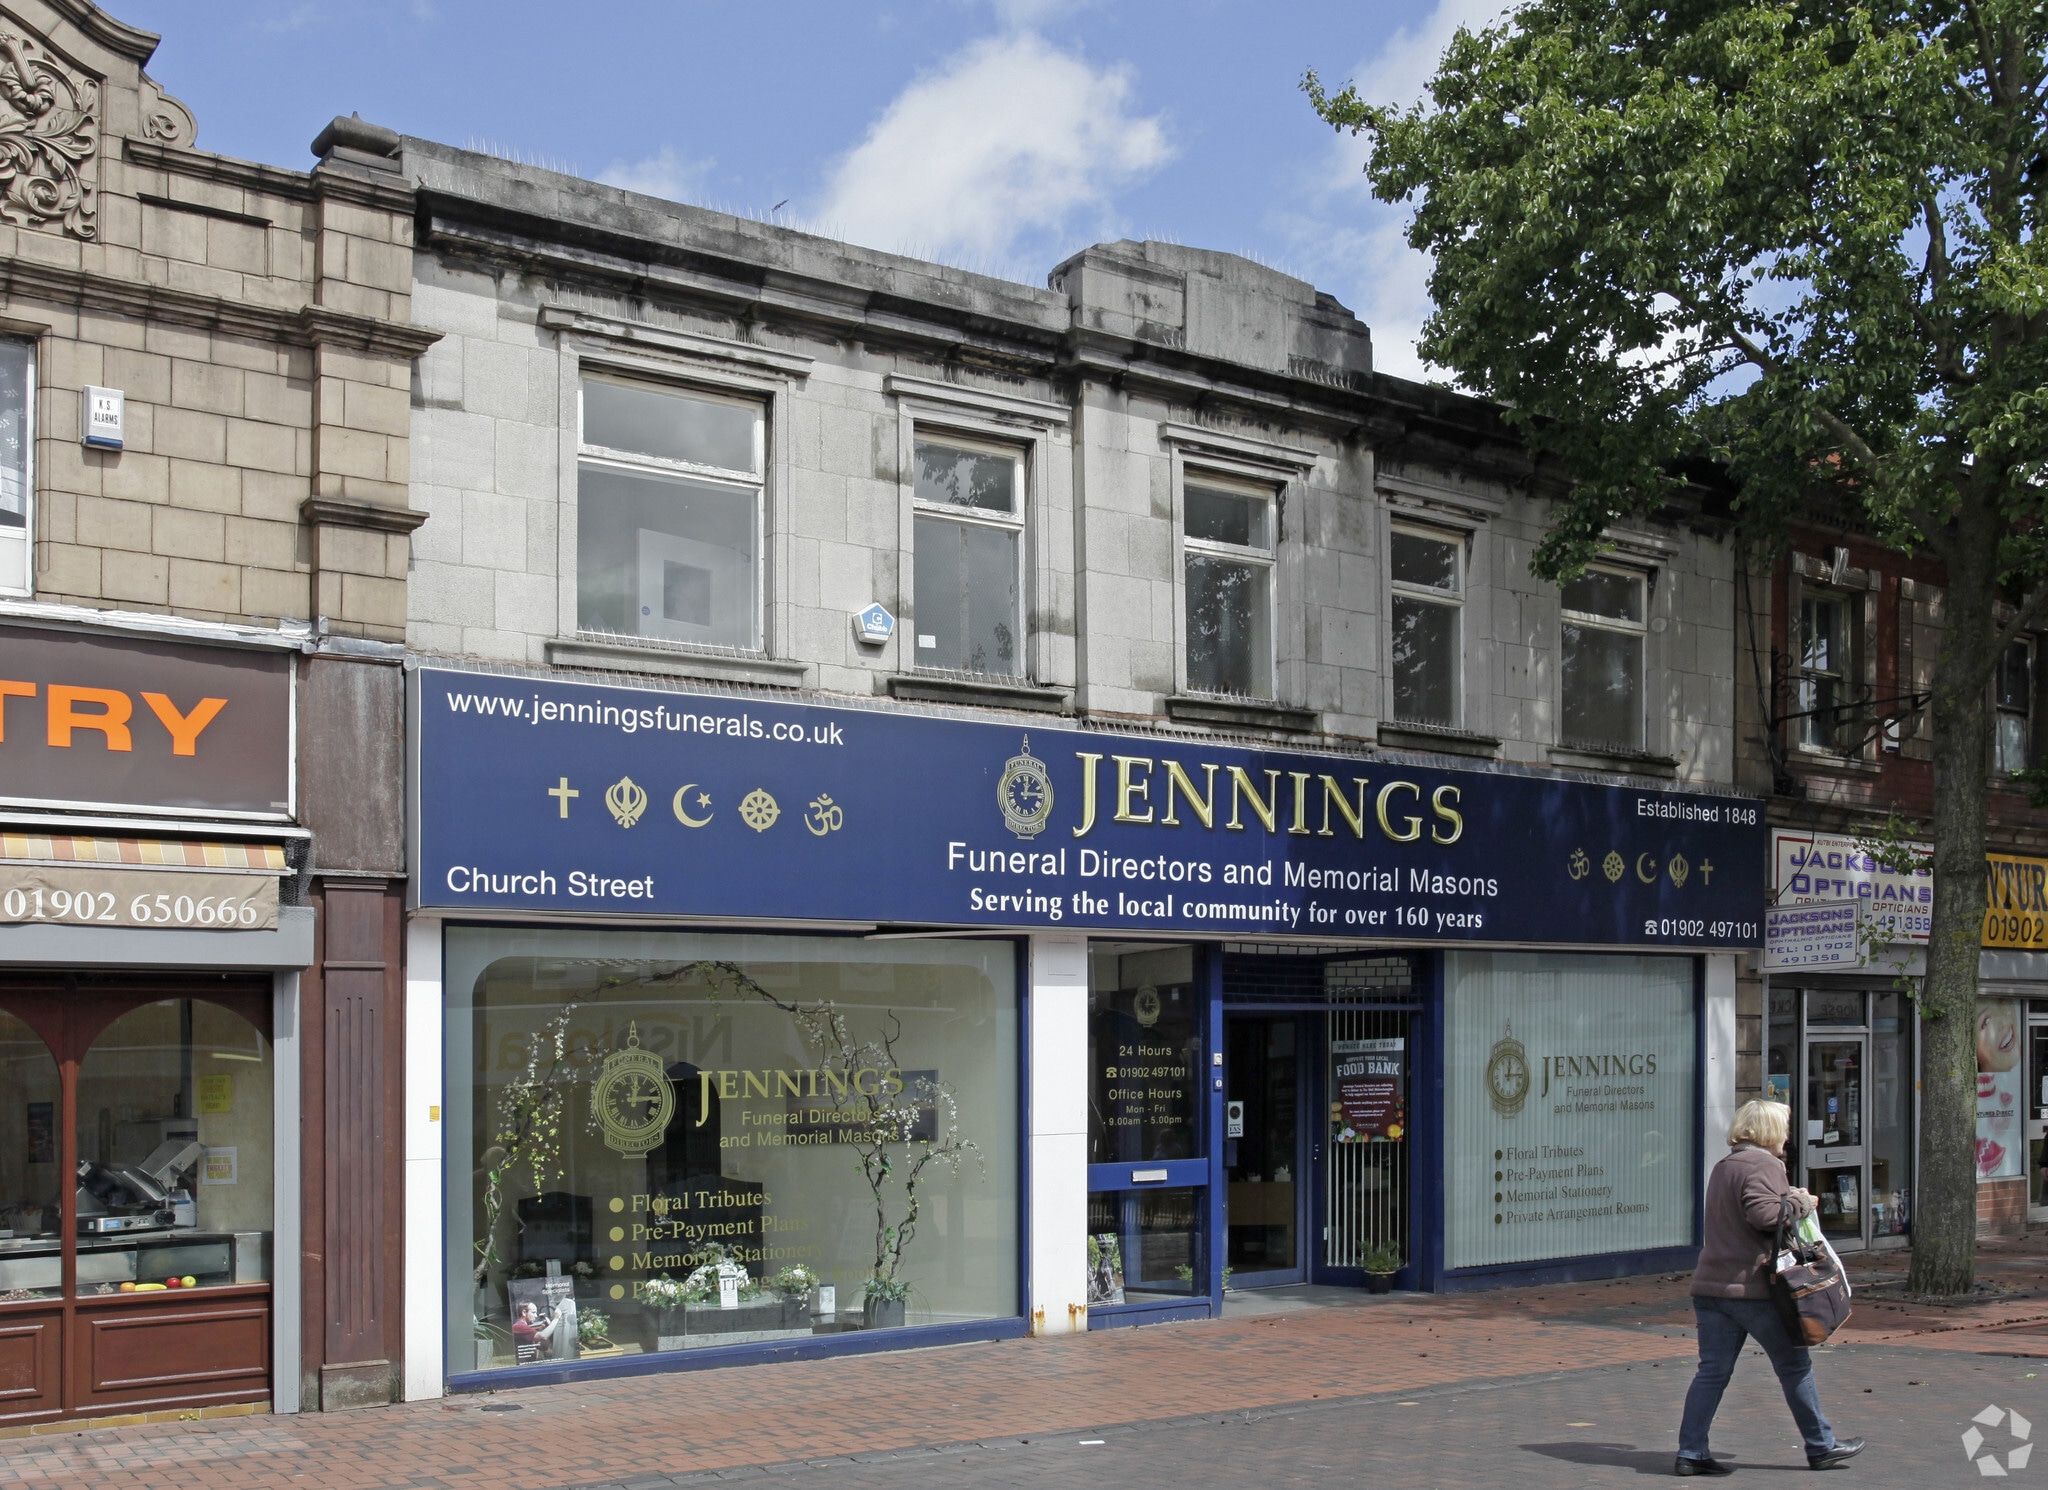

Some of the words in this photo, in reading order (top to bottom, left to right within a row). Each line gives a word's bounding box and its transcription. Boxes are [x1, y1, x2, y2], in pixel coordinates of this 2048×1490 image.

[94, 412, 118, 425] ALARMS
[866, 623, 888, 632] Chubb
[446, 691, 845, 747] www.jenningsfunerals.co.uk
[1072, 750, 1465, 846] JENNINGS
[1637, 798, 1719, 822] Established
[1724, 807, 1757, 826] 1848
[948, 841, 1066, 876] Funeral
[1079, 848, 1213, 884] Directors
[1223, 860, 1273, 887] and
[1283, 861, 1399, 892] Memorial
[1409, 867, 1499, 897] Masons
[446, 865, 557, 897] Church
[567, 870, 655, 899] Street
[1790, 873, 1933, 904] OPTICIANS
[4, 887, 117, 922] 01902
[130, 892, 258, 925] 650666
[970, 887, 1063, 921] Serving
[1071, 890, 1109, 915] the
[1118, 892, 1173, 918] local
[1182, 899, 1301, 929] community
[1308, 900, 1338, 924] for
[1344, 909, 1387, 926] over
[1395, 906, 1430, 927] 160
[1435, 911, 1483, 933] years
[1872, 902, 1929, 915] OPTICIANS
[1768, 908, 1855, 926] JACKSONS
[1660, 918, 1704, 937] 01902
[1709, 920, 1757, 939] 497101
[1767, 922, 1856, 939] OPTICIANS
[1988, 914, 2045, 943] 01902
[1768, 946, 1799, 954] TEL:
[1804, 941, 1854, 953] 01902
[1769, 936, 1814, 945] OPHTHALMIC
[1780, 953, 1841, 965] 491358
[1119, 1045, 1133, 1056] 24
[1138, 1045, 1172, 1056] Hours
[611, 1055, 657, 1067] FUNERAL
[1336, 1062, 1365, 1078] FOOD
[1368, 1062, 1400, 1076] BANK
[1120, 1067, 1150, 1078] 01902
[1151, 1066, 1186, 1078] 497101
[1541, 1053, 1657, 1098] JENNINGS
[695, 1067, 904, 1128] JENNINGS
[1108, 1089, 1144, 1100] Office
[1148, 1088, 1182, 1099] Hours
[1566, 1086, 1601, 1097] Funeral
[1604, 1085, 1645, 1096] Directors
[1126, 1105, 1145, 1114] Mon
[1154, 1104, 1166, 1113] Fri
[1554, 1102, 1572, 1114] and
[1575, 1100, 1618, 1113] Memorial
[1620, 1099, 1655, 1111] Masons
[741, 1109, 803, 1126] Funeral
[809, 1108, 881, 1125] Directors
[1108, 1117, 1141, 1126] 9.00am
[1150, 1115, 1182, 1126] 5.00pm
[719, 1132, 751, 1148] and
[757, 1130, 832, 1146] Memorial
[838, 1128, 900, 1144] Masons
[1825, 1134, 1838, 1142] OPEN
[1507, 1146, 1538, 1160] Floral
[1541, 1144, 1584, 1158] Tributes
[1507, 1166, 1574, 1183] Pre-Payment
[1577, 1163, 1605, 1177] Plans
[631, 1192, 690, 1213] Floral
[694, 1190, 772, 1210] Tributes
[1507, 1187, 1558, 1203] Memorial
[1561, 1183, 1614, 1199] Stationery
[1507, 1210, 1544, 1225] Private
[1547, 1206, 1613, 1222] Arrangement
[1616, 1201, 1650, 1215] Rooms
[631, 1218, 755, 1243] Pre-Payment
[760, 1215, 810, 1234] Plans
[631, 1247, 725, 1270] Memorial
[732, 1242, 824, 1263] Stationery
